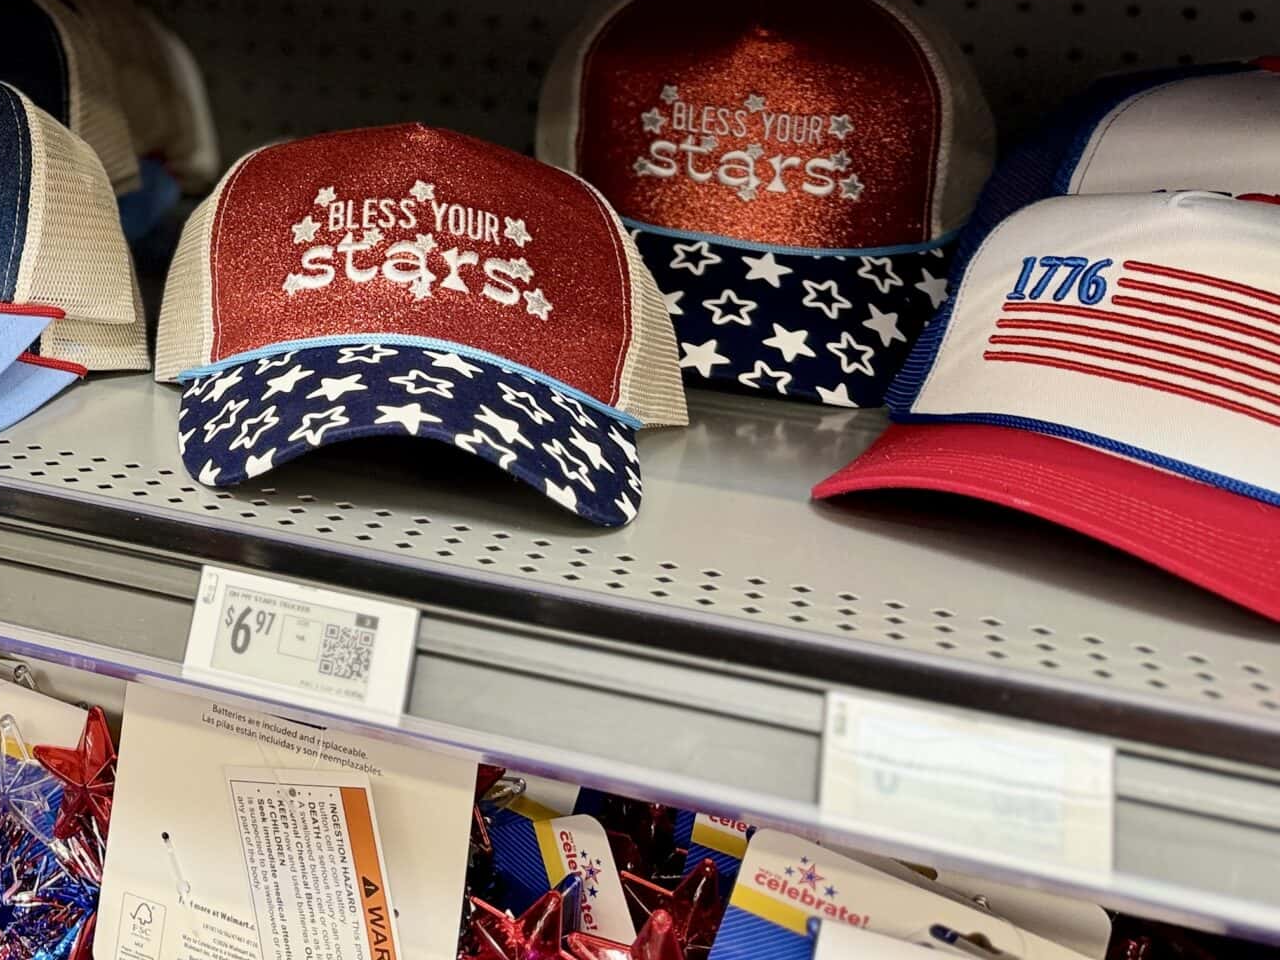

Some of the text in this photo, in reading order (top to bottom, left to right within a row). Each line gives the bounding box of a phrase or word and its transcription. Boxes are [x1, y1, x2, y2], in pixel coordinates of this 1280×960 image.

[673, 102, 824, 144] BLESS YOUR
[648, 134, 835, 197] stars
[329, 199, 500, 245] BLESS YOUR
[298, 232, 520, 306] stars
[1006, 256, 1113, 306] 1776
[212, 704, 246, 722] Batteries
[248, 718, 261, 727] are
[262, 721, 298, 739] included
[299, 733, 316, 744] and
[202, 714, 215, 724] Las
[216, 717, 235, 732] pilas
[235, 725, 257, 738] están
[258, 732, 295, 751] incluidas
[303, 747, 318, 757] son
[319, 751, 384, 777] reemplazables.
[234, 795, 245, 812] any
[239, 815, 250, 834] part
[256, 798, 268, 822] Seek
[275, 799, 289, 828] KEEP
[306, 801, 321, 839] DEATH
[316, 801, 331, 832] button
[246, 807, 264, 855] suspected
[260, 825, 280, 878] immediate
[265, 798, 287, 866] of CHILDREN
[327, 802, 348, 862] INGESTION
[246, 848, 256, 863] the
[286, 854, 297, 872] and
[297, 811, 316, 860] swallowed
[308, 864, 322, 894] button
[271, 881, 287, 921] medical
[290, 875, 302, 898] used
[293, 841, 311, 889] Chemical
[304, 892, 318, 923] Burns
[755, 871, 870, 927] celebrate!
[194, 904, 210, 915] more
